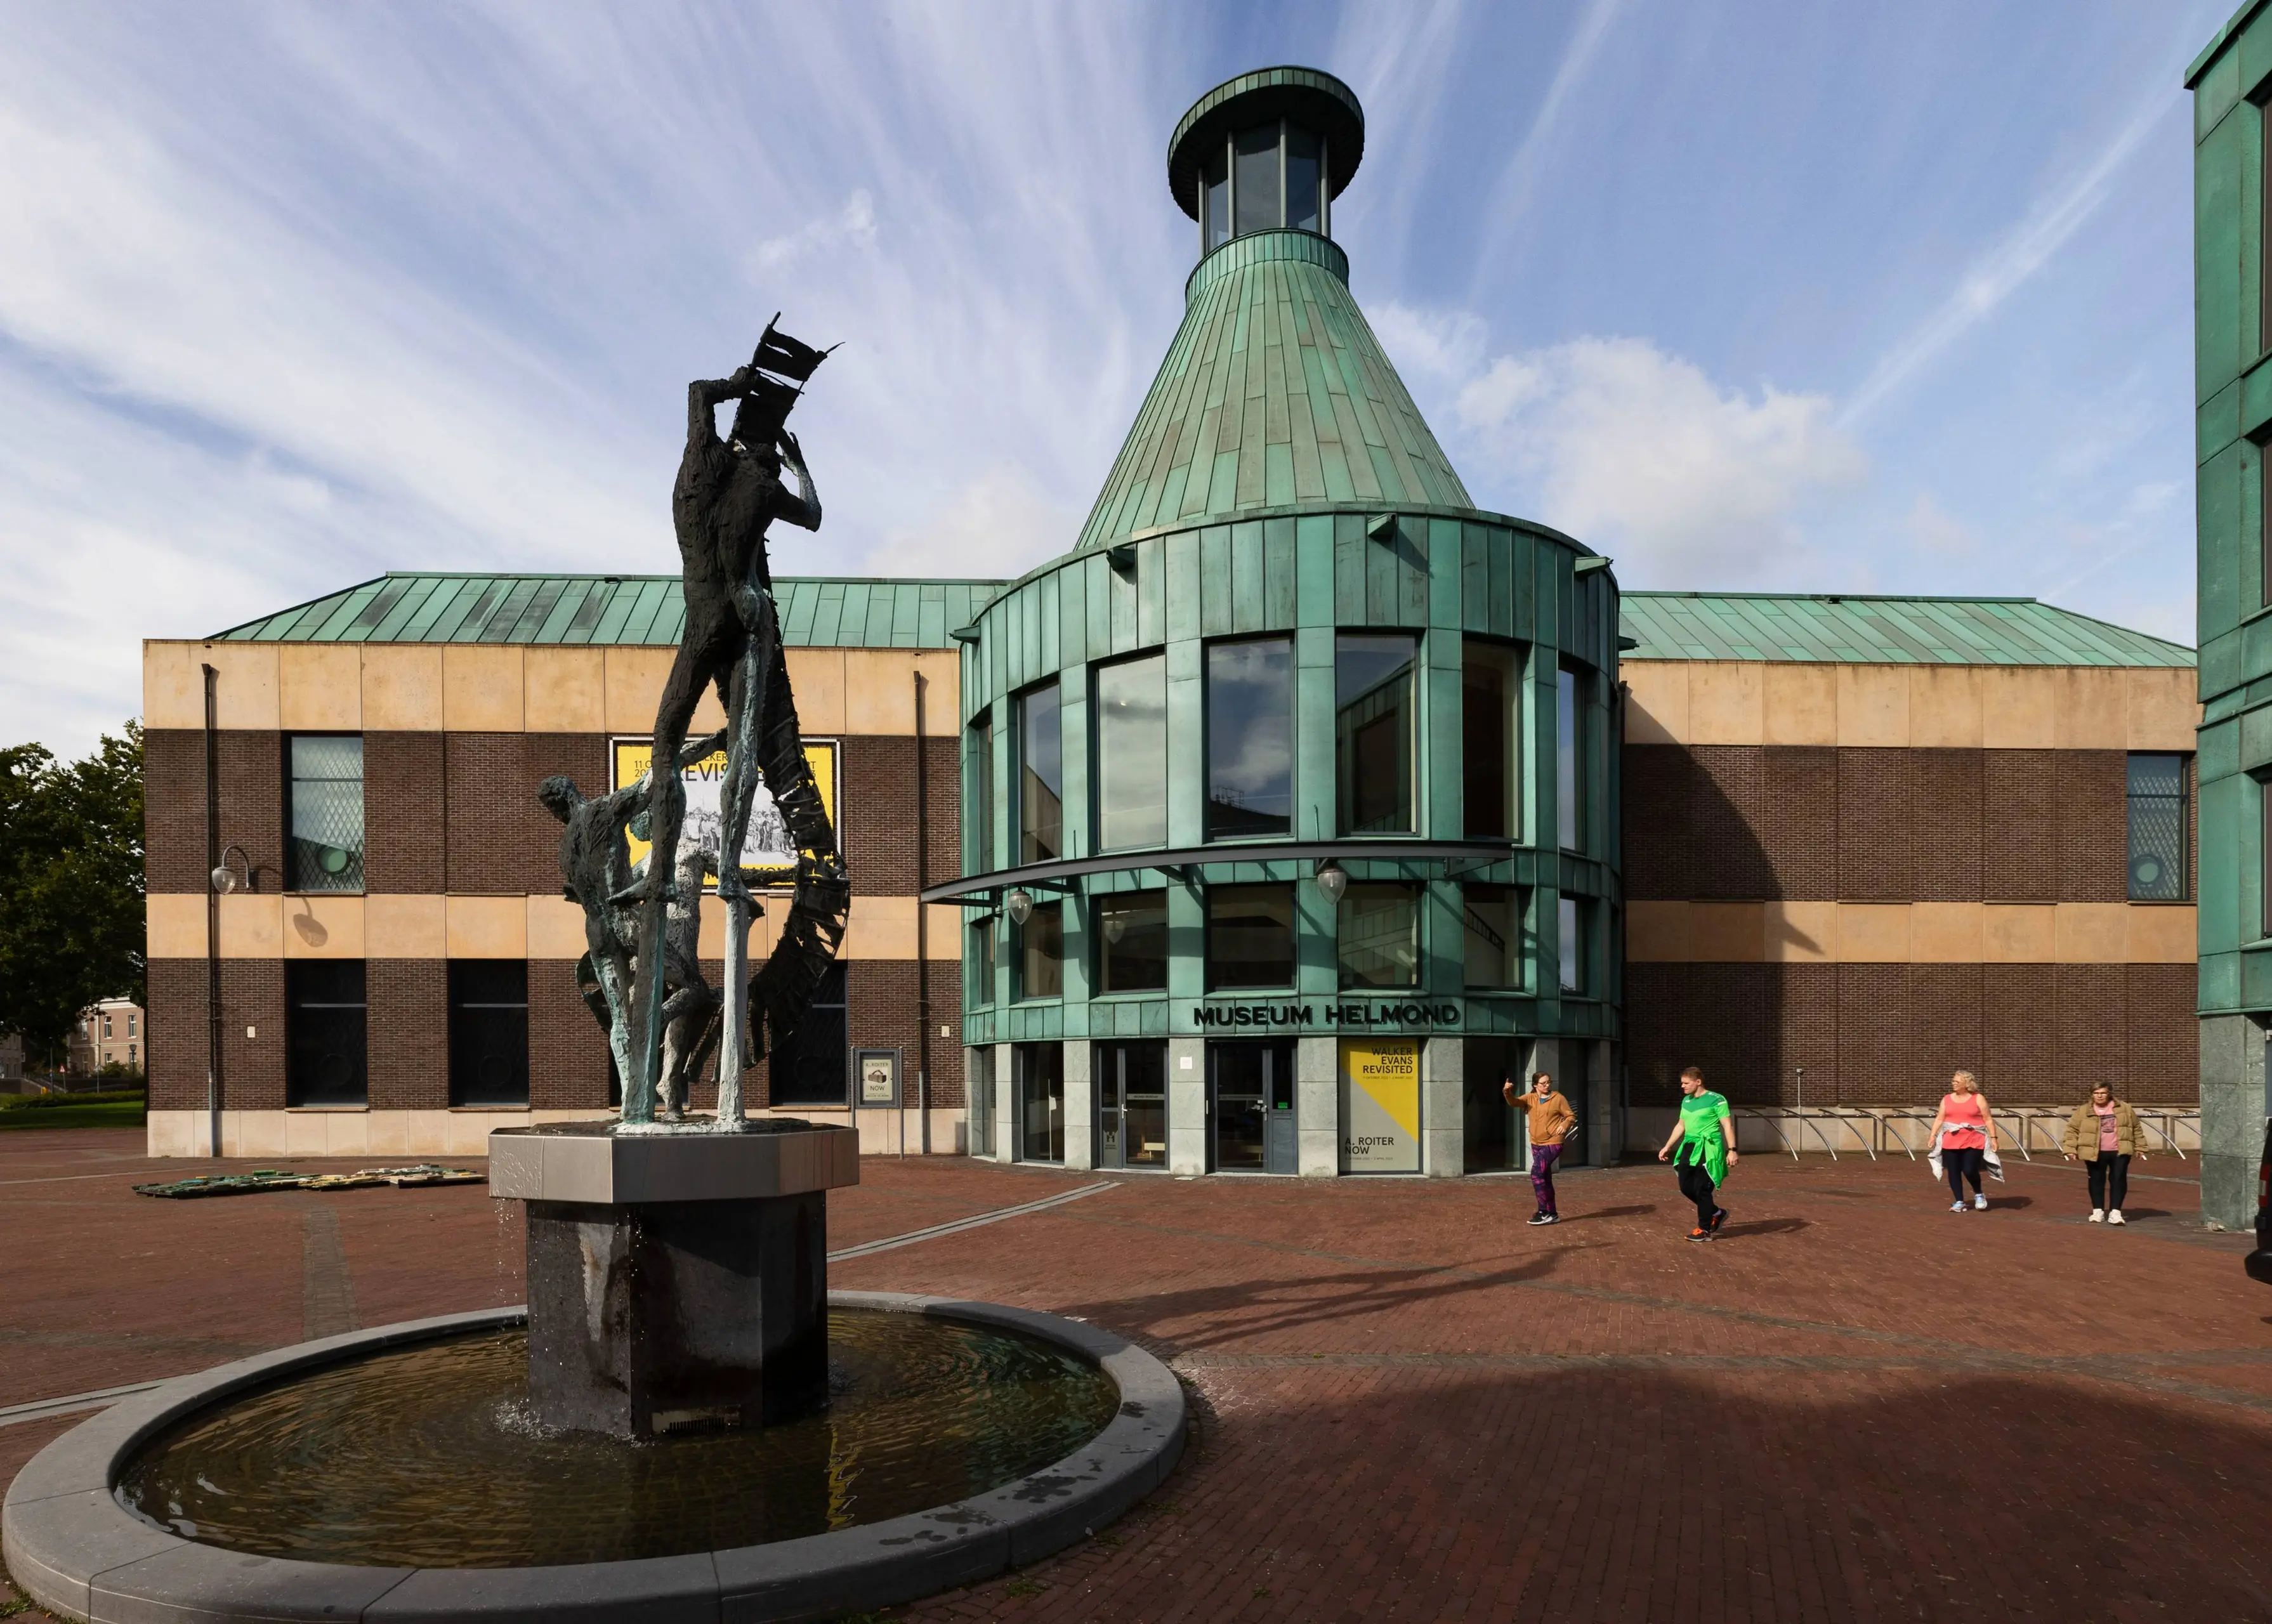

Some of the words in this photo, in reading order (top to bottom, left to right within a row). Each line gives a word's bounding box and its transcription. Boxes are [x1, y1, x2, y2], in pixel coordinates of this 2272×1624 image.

[634, 760, 642, 768] 11
[1194, 1005, 1311, 1026] MUSEUM
[1325, 1004, 1461, 1026] HELMOND
[1372, 1047, 1412, 1056] WALKER
[1381, 1056, 1413, 1064] EVANS
[1363, 1065, 1413, 1073] REVISITED
[1345, 1137, 1355, 1145] A.
[1358, 1137, 1395, 1145] ROITER
[1345, 1146, 1370, 1155] NOW
